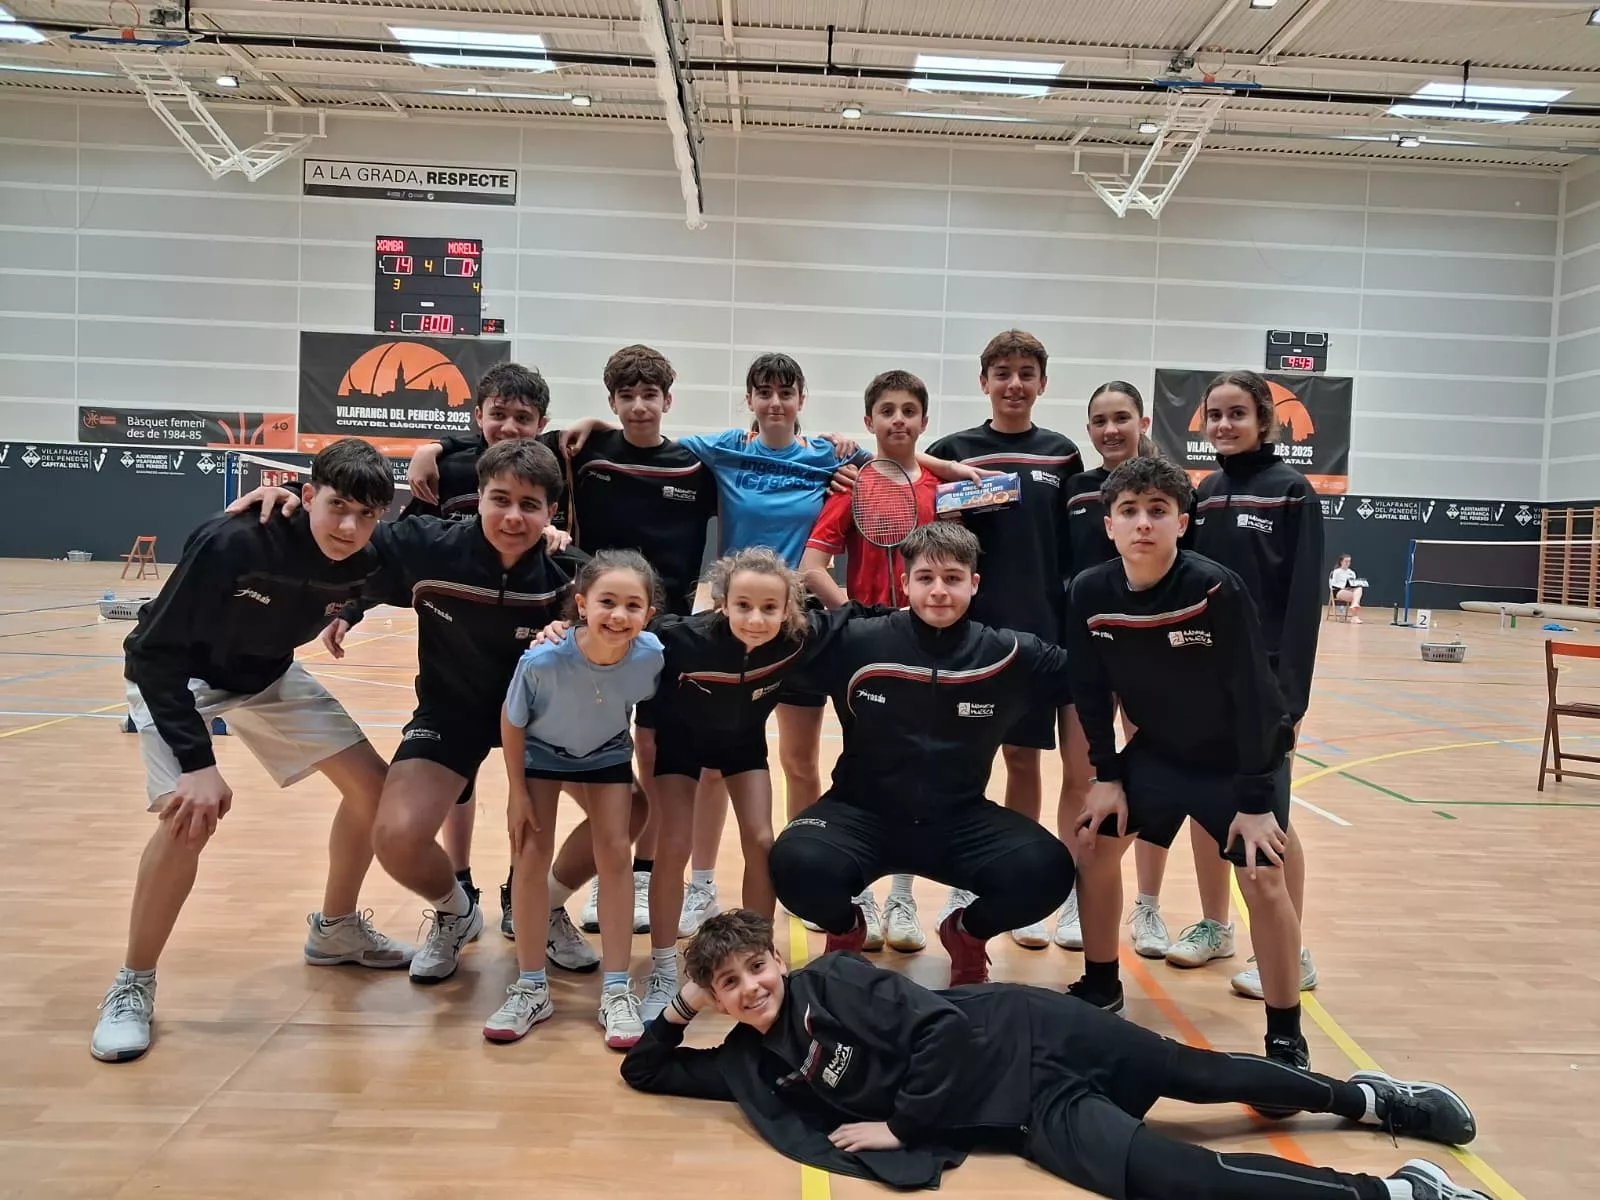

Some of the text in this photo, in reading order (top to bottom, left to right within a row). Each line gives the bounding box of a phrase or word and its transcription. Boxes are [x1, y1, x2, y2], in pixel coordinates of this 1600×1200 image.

[312, 166, 509, 188] A LA GRADA, RESPECTE
[396, 258, 411, 273] 14
[424, 260, 433, 272] 4
[393, 278, 401, 290] 3
[472, 281, 480, 293] 4
[421, 315, 452, 332] 1:00
[336, 405, 471, 423] VILAFRANCA DEL PENEDÈS 2025
[127, 416, 168, 428] Bàsquet
[171, 417, 205, 428] femení
[336, 419, 367, 427] CIUTAT
[390, 421, 432, 430] BÀSQUET
[434, 423, 471, 431] CATALÀ
[127, 429, 202, 440] des de 1984-85
[1291, 445, 1313, 457] 2025
[1419, 614, 1427, 625] 2
